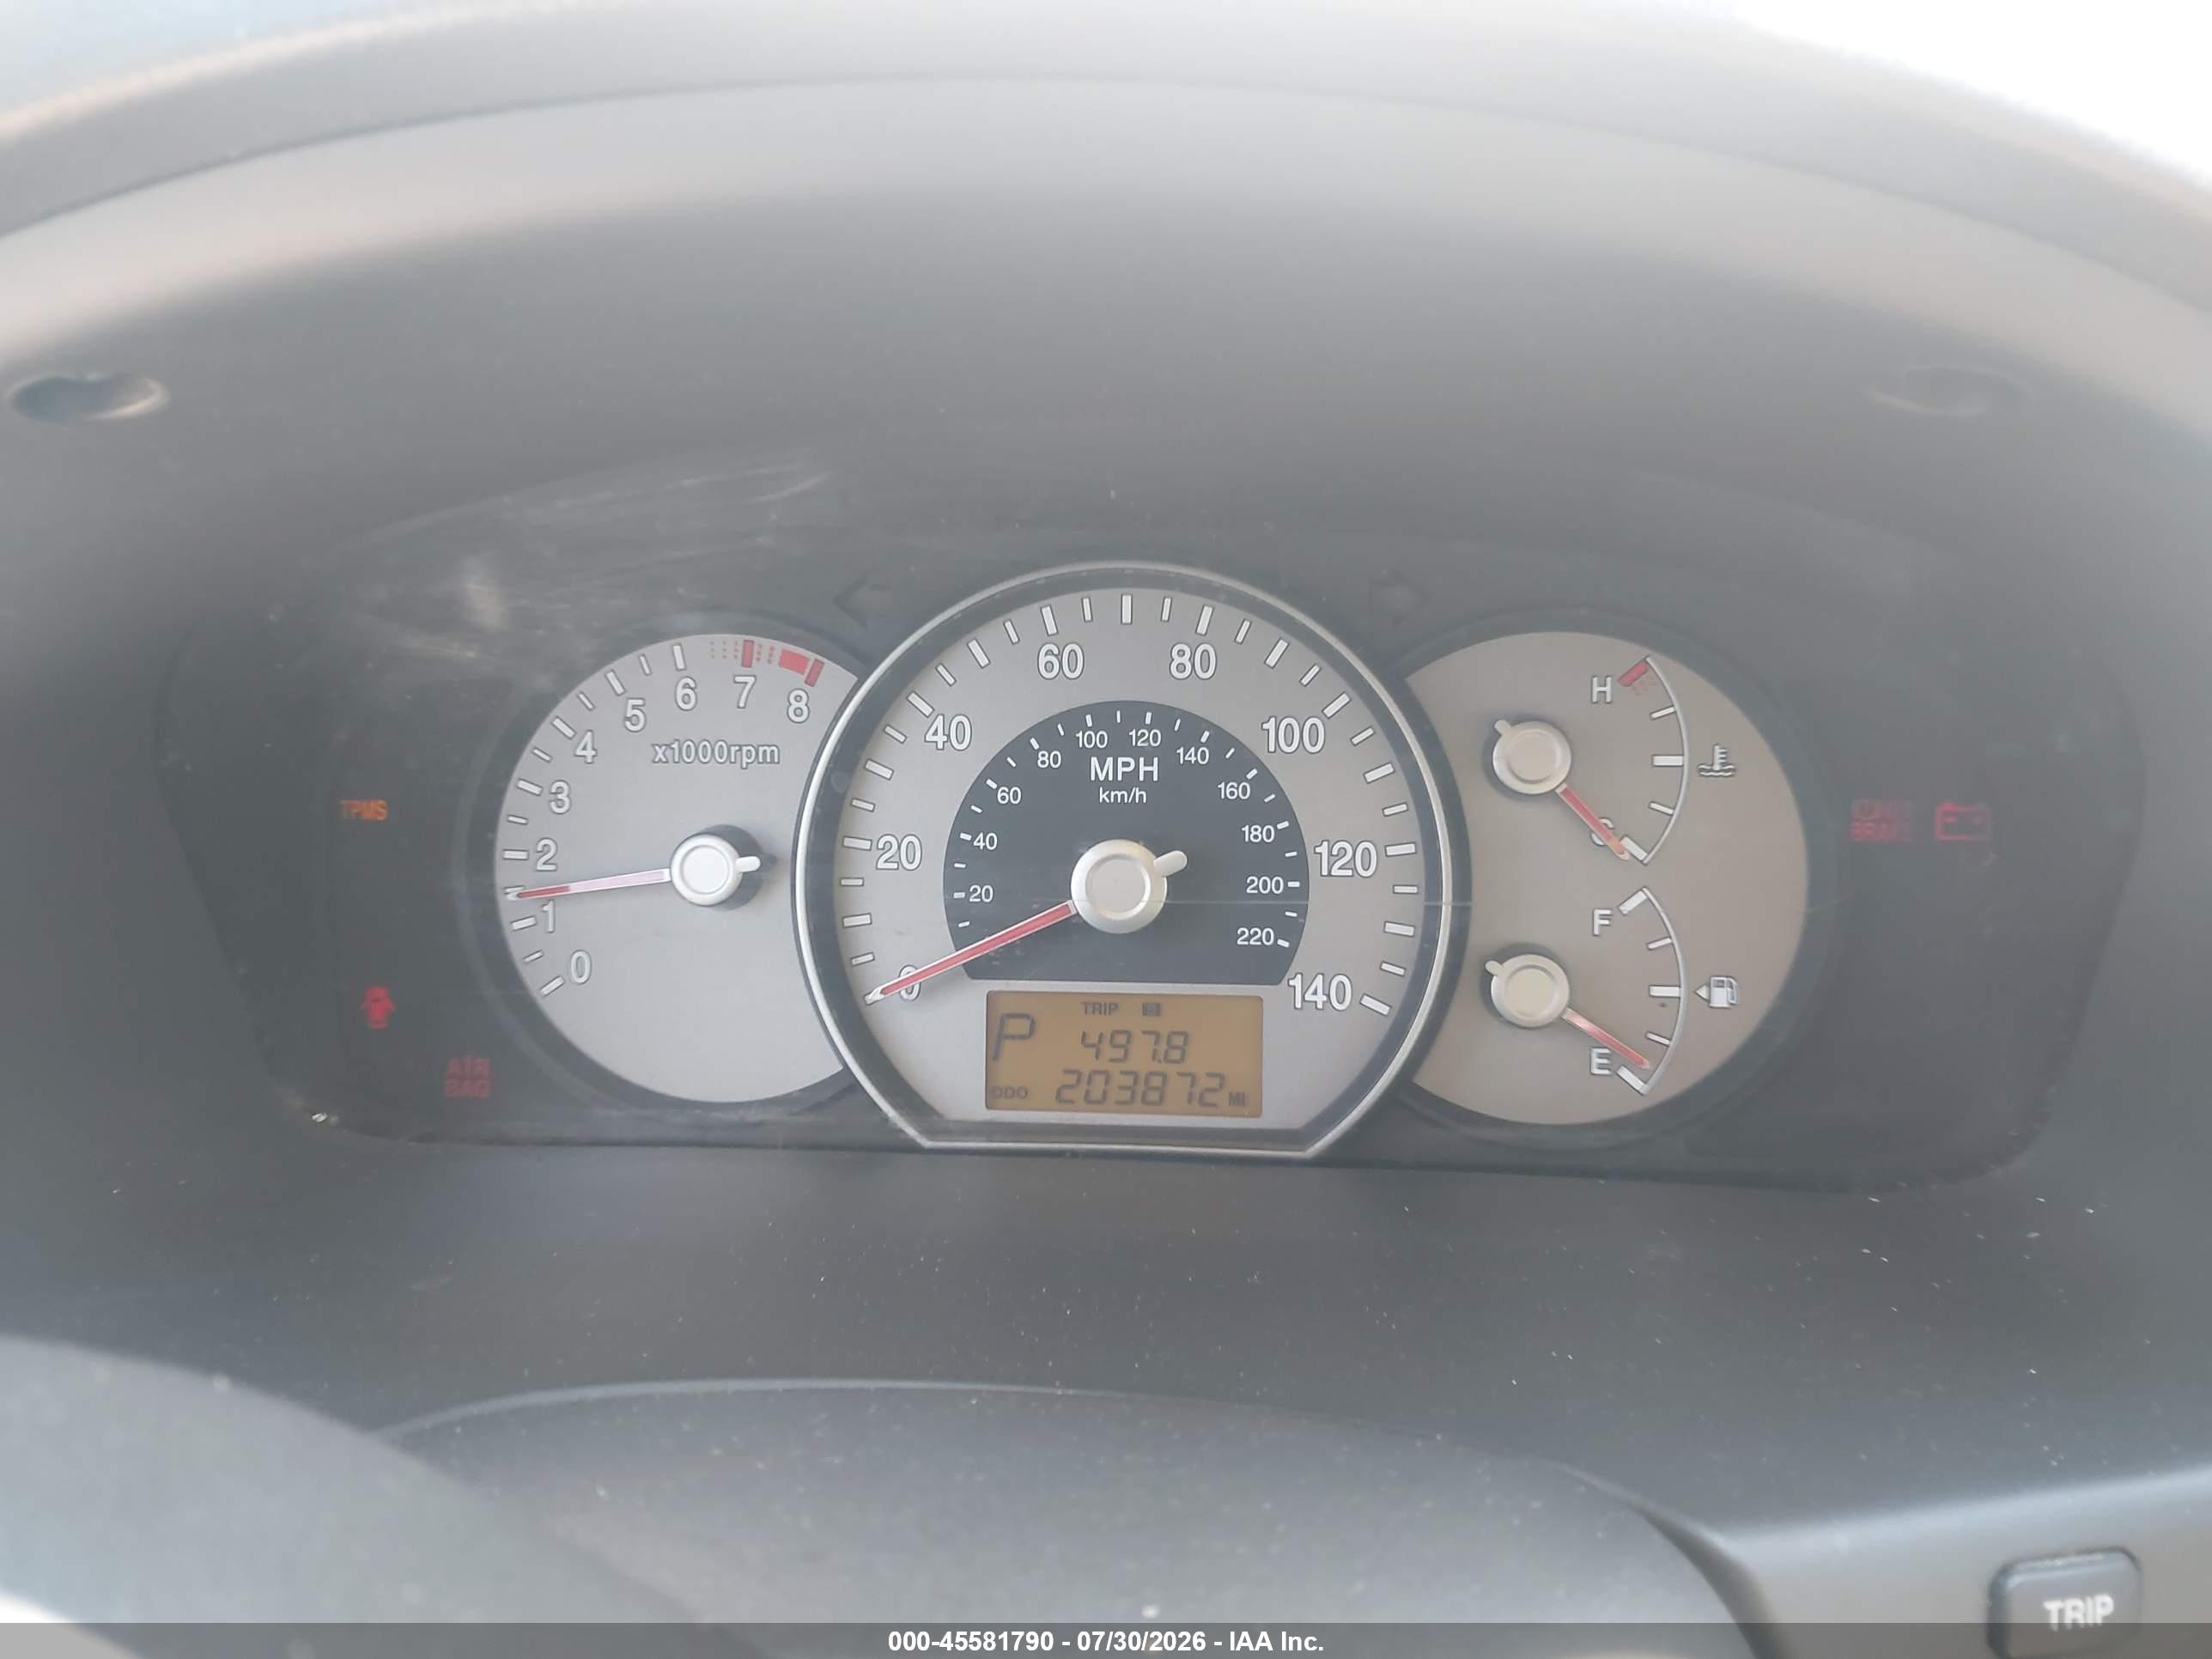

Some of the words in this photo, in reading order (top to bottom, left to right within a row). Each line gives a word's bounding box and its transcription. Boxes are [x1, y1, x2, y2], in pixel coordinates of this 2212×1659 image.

[1037, 643, 1085, 679] 60
[1170, 643, 1217, 680] 80
[675, 677, 697, 710] 6
[733, 676, 756, 708] 7
[1590, 676, 1613, 703] H
[623, 697, 646, 732] 5
[787, 689, 809, 723] 8
[574, 730, 597, 763] 4
[925, 714, 972, 750] 40
[1076, 731, 1108, 749] 100
[1128, 730, 1162, 747] 120
[1261, 716, 1326, 754] 100
[653, 739, 780, 769] x1000rpm
[1037, 750, 1062, 769] 80
[1090, 757, 1158, 781] MPH
[1176, 746, 1209, 765] 140
[549, 780, 571, 814] 3
[997, 787, 1022, 805] 60
[1099, 787, 1147, 804] km/h
[1218, 782, 1251, 800] 160
[973, 832, 998, 850] 40
[1242, 824, 1275, 843] 180
[535, 838, 557, 872] 2
[876, 834, 922, 871] 20
[1314, 840, 1377, 878] 120
[969, 884, 994, 902] 20
[1246, 876, 1284, 895] 200
[540, 901, 556, 933] 1
[1593, 908, 1612, 937] F
[1237, 927, 1274, 945] 220
[570, 951, 592, 984] 0
[1288, 973, 1352, 1012] 140
[1081, 1002, 1119, 1016] TRIP
[993, 1013, 1036, 1060] P
[1590, 1047, 1612, 1076] E
[991, 1085, 1029, 1099] ODO
[1055, 1069, 1224, 1108] 203872
[2043, 1594, 2114, 1632] TRIP
